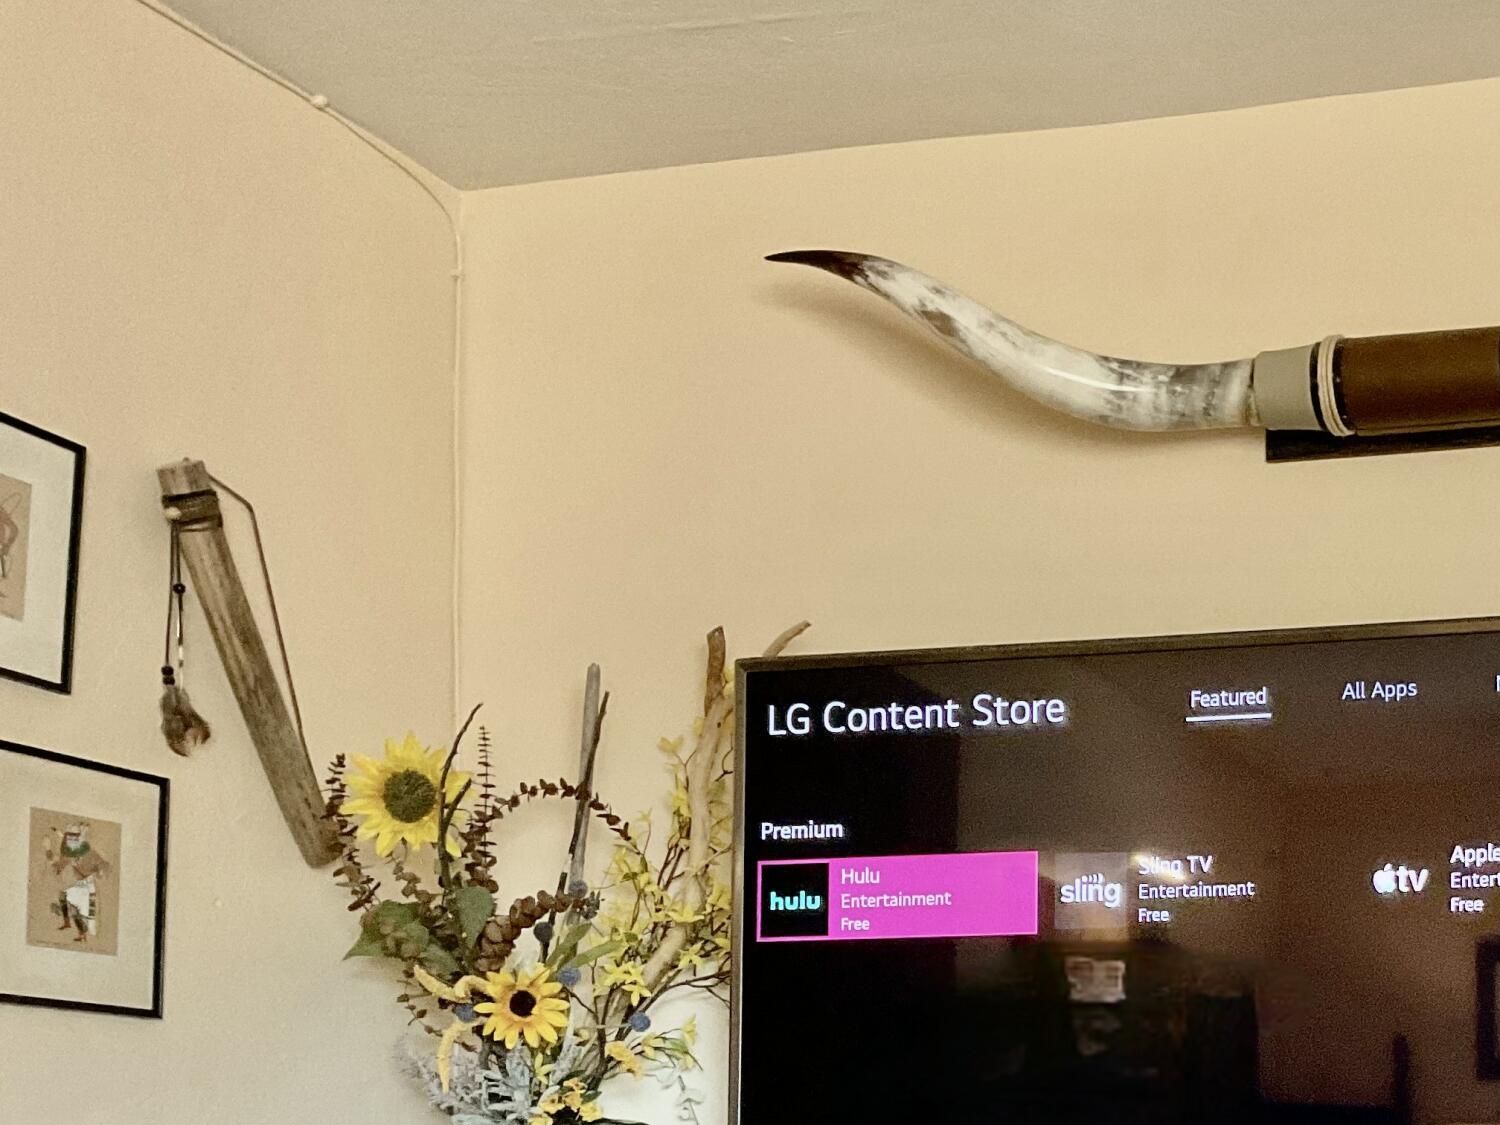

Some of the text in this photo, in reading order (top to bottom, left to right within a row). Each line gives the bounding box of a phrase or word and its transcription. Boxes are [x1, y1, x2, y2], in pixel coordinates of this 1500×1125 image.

[1190, 687, 1268, 709] Featured
[1342, 681, 1418, 702] All Apps
[768, 693, 1065, 736] LG Content Store
[761, 820, 844, 840] Premium
[1138, 855, 1213, 876] Sling TV
[841, 867, 880, 885] Hulu
[1397, 864, 1428, 892] tv
[841, 891, 952, 909] Entertainment
[1060, 874, 1121, 907] sling
[1138, 881, 1255, 899] Entertainment
[769, 890, 822, 911] hulu
[1450, 897, 1484, 912] Free
[841, 917, 870, 931] Free
[1138, 907, 1169, 922] Free
